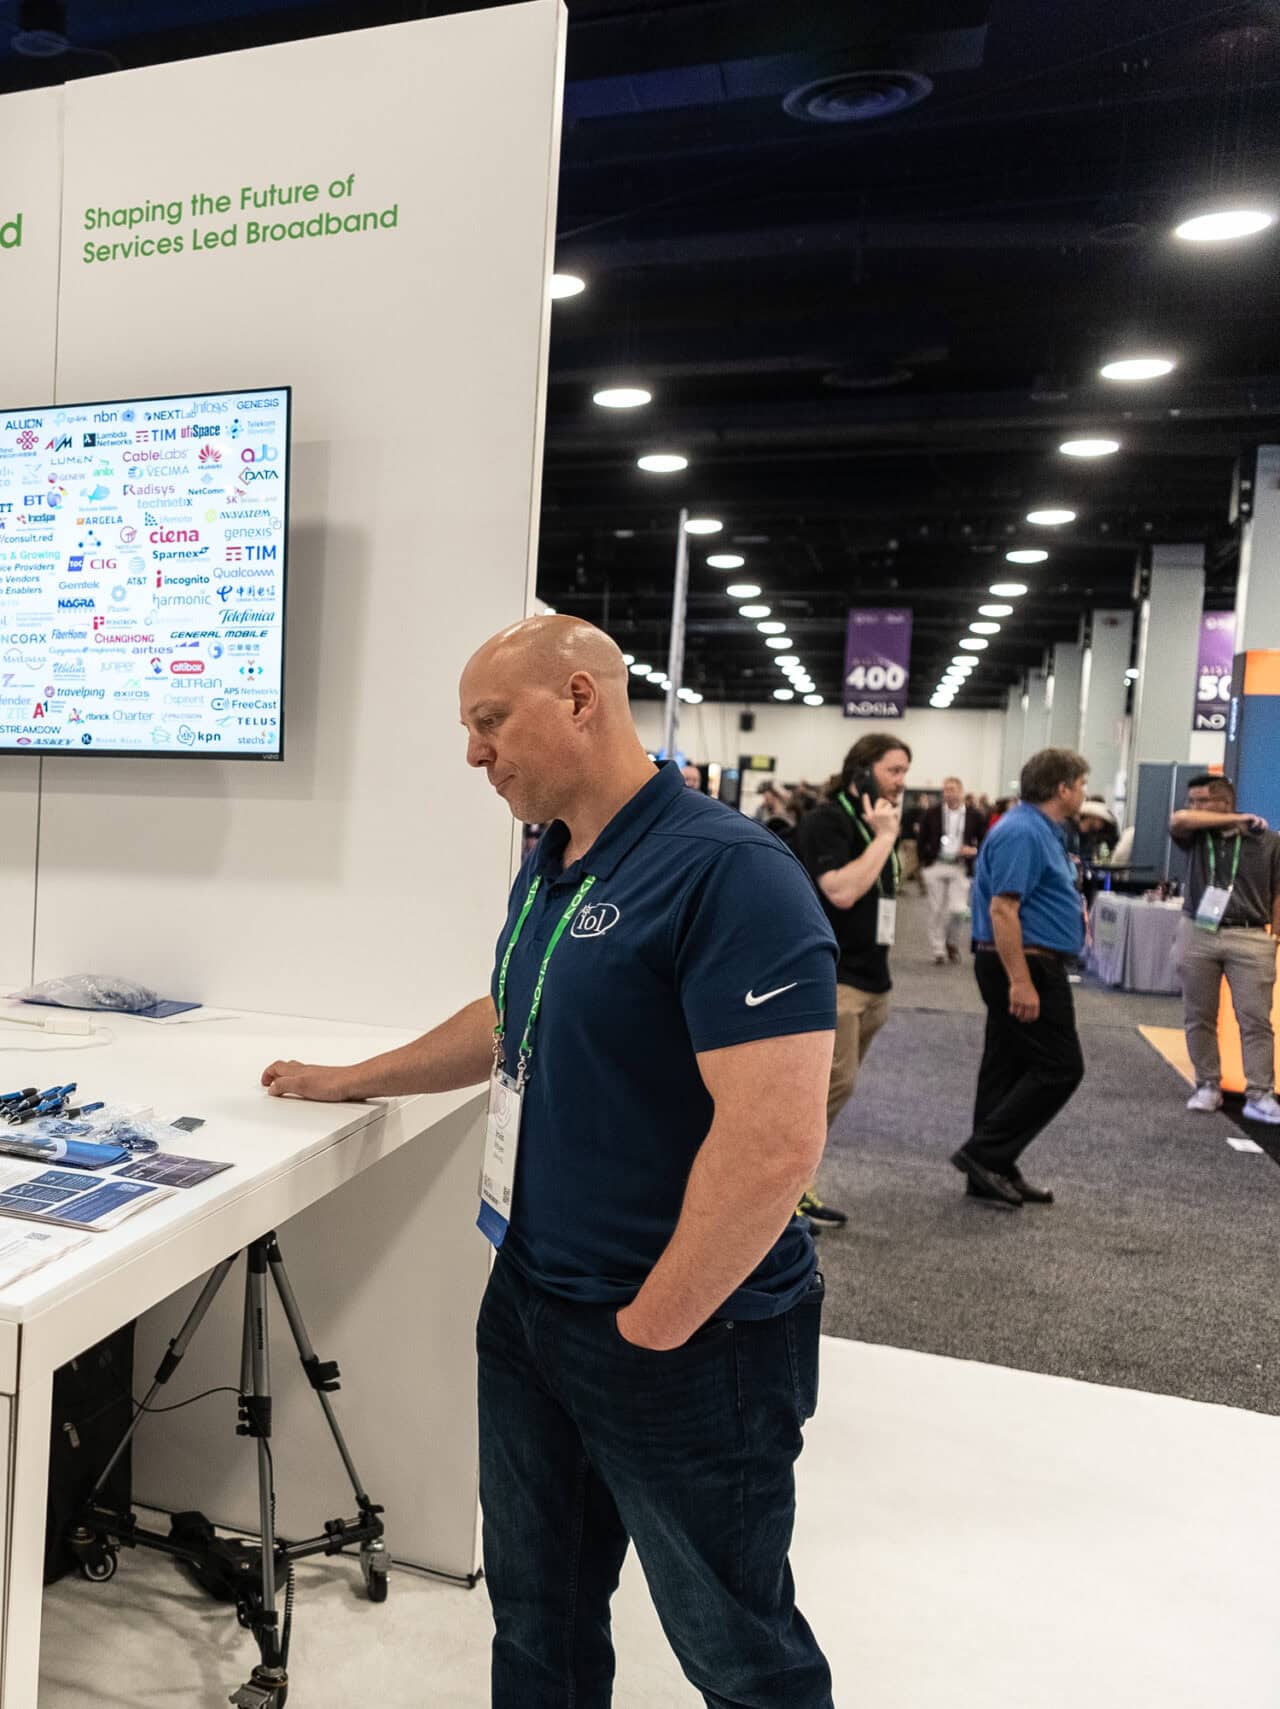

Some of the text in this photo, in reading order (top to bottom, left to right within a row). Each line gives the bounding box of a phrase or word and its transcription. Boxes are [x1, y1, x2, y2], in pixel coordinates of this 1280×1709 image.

[84, 174, 356, 232] Shaping the Future of
[82, 205, 400, 264] Services Led Broadband
[237, 398, 280, 409] GENESIS
[93, 410, 118, 423] nbn
[5, 418, 43, 430] ALLION
[152, 429, 176, 441] TIM
[181, 425, 221, 439] ufiSpace
[122, 449, 187, 462] CableLabs
[146, 466, 189, 477] VECIMA
[123, 484, 175, 496] Radisys
[188, 488, 225, 496] NetComm
[24, 494, 44, 506] BT
[86, 515, 123, 525] ARGELA
[149, 526, 199, 544] ciena
[224, 528, 273, 542] genexis
[10, 551, 17, 560] &
[20, 550, 61, 561] Growing
[152, 550, 200, 561] Sparnex
[245, 545, 277, 560] TIM
[14, 563, 55, 572] Providers
[90, 559, 117, 569] CIG
[6, 575, 40, 583] Vendors
[127, 577, 148, 585] AT&T
[164, 575, 210, 586] incognito
[6, 586, 42, 595] Enablers
[58, 600, 95, 608] NAGRA
[153, 592, 211, 608] harmonic
[170, 630, 269, 639] GENERAL MOBILE
[847, 666, 906, 691] 400
[57, 687, 106, 699] travelping
[224, 687, 240, 695] APS
[231, 700, 277, 709] FreeCast
[112, 710, 154, 721] Charter
[237, 716, 277, 726] TELUS
[198, 731, 222, 744] kpn
[577, 909, 607, 933] iol
